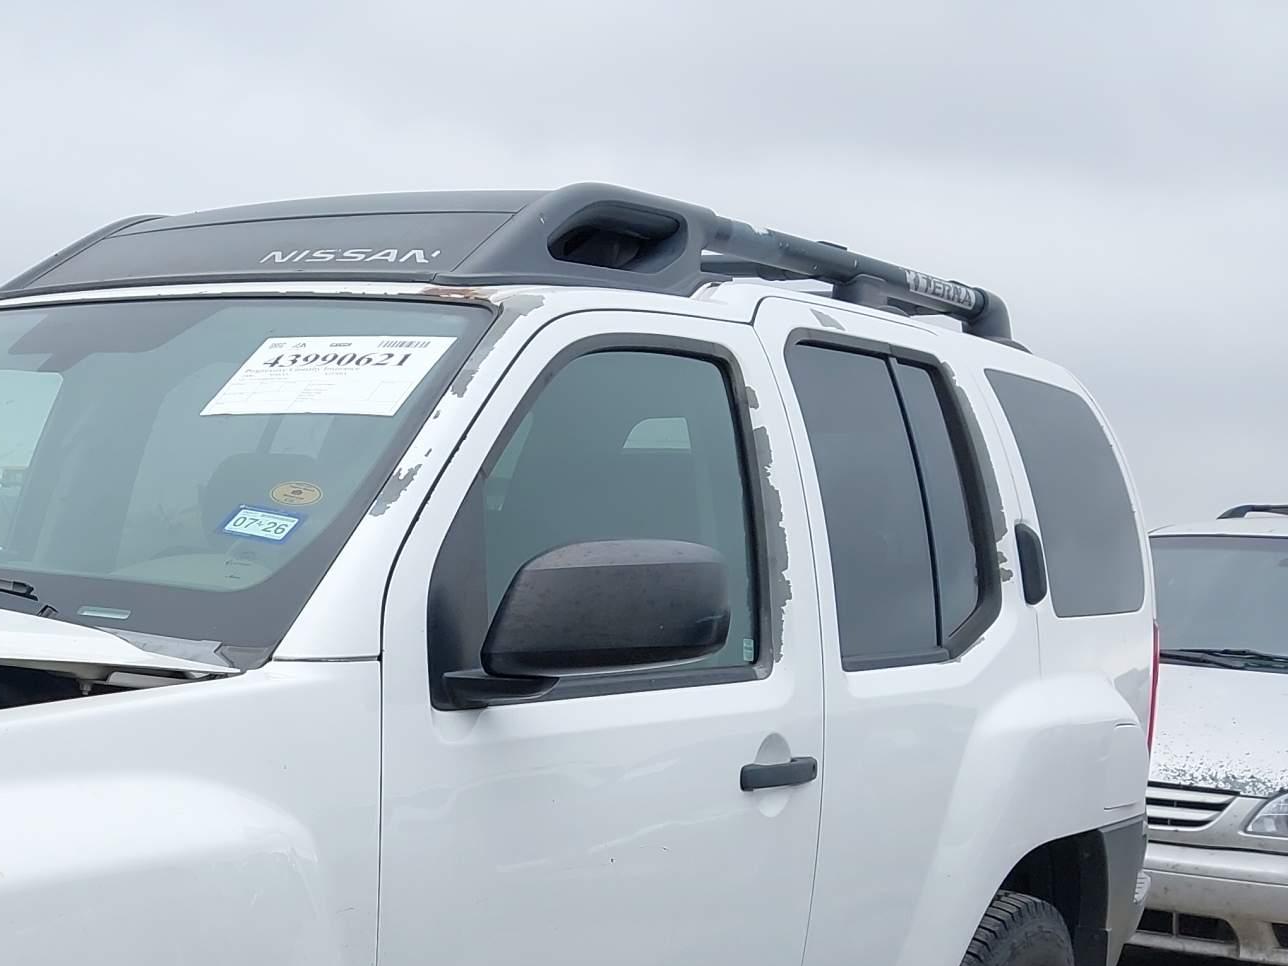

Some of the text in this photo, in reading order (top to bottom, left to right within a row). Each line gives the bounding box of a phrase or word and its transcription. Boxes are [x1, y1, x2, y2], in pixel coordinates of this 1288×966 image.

[259, 248, 441, 264] NISSAN
[263, 352, 413, 368] 43990621
[232, 516, 289, 535] 07 26
